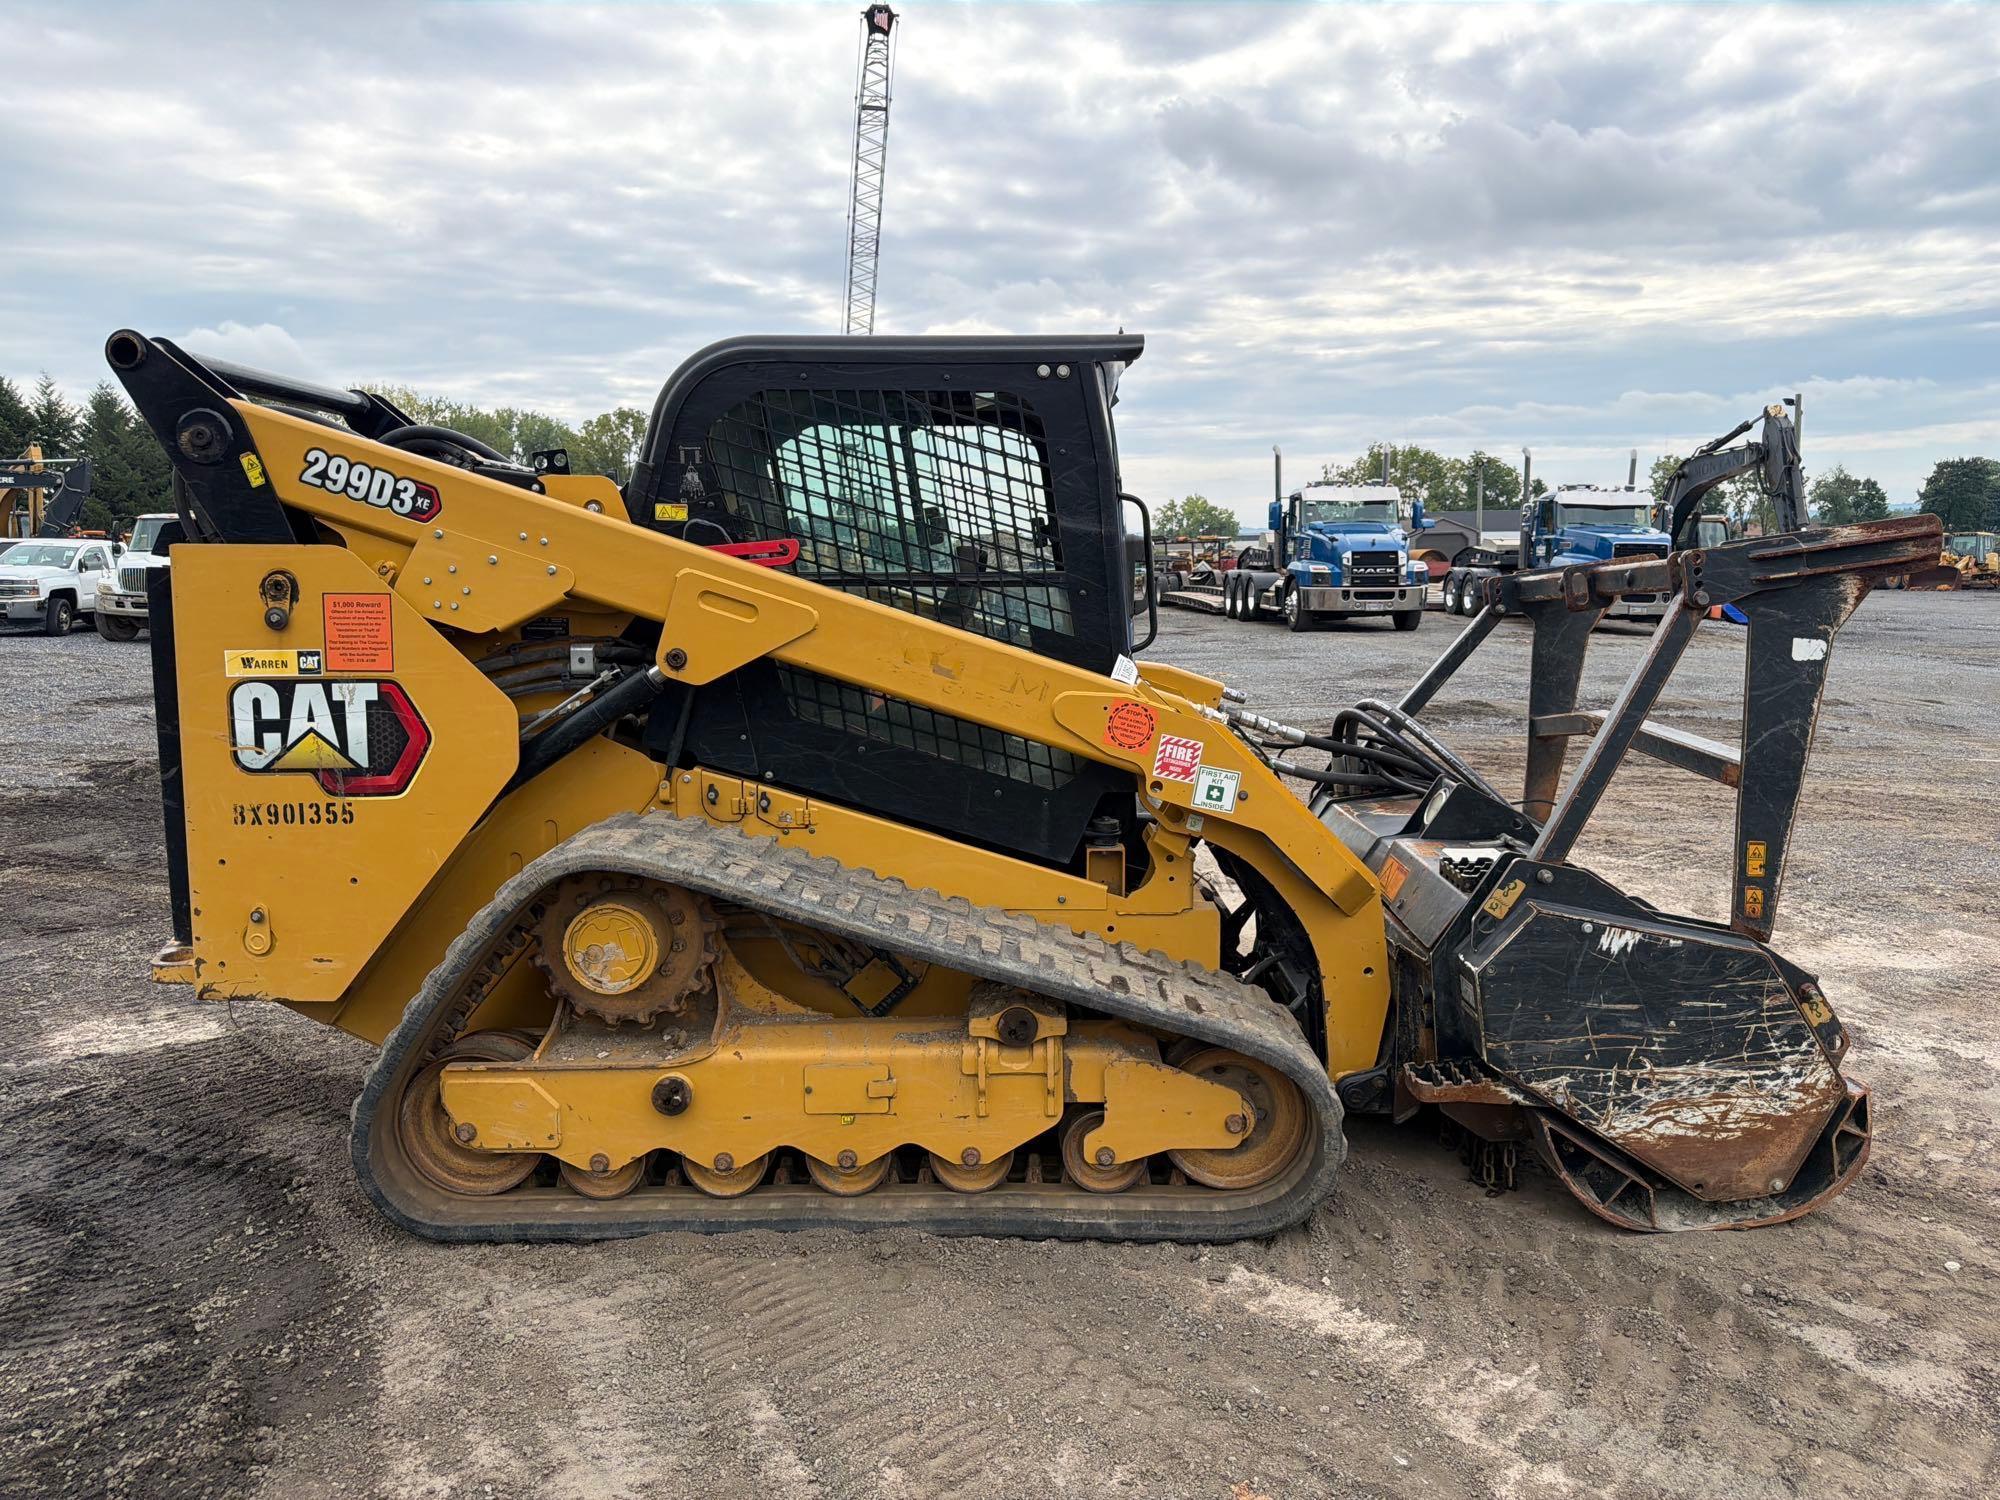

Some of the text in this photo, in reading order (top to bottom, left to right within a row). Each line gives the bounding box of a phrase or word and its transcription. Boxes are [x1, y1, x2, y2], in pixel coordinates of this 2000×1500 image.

[301, 449, 431, 514] 299D3 XE
[299, 655, 320, 669] CAT
[233, 682, 379, 769] CAT
[1164, 744, 1194, 762] FIRE
[1163, 757, 1191, 768] EXTINGUISHER
[1201, 769, 1222, 779] FIRST
[1200, 801, 1225, 810] INSIDE
